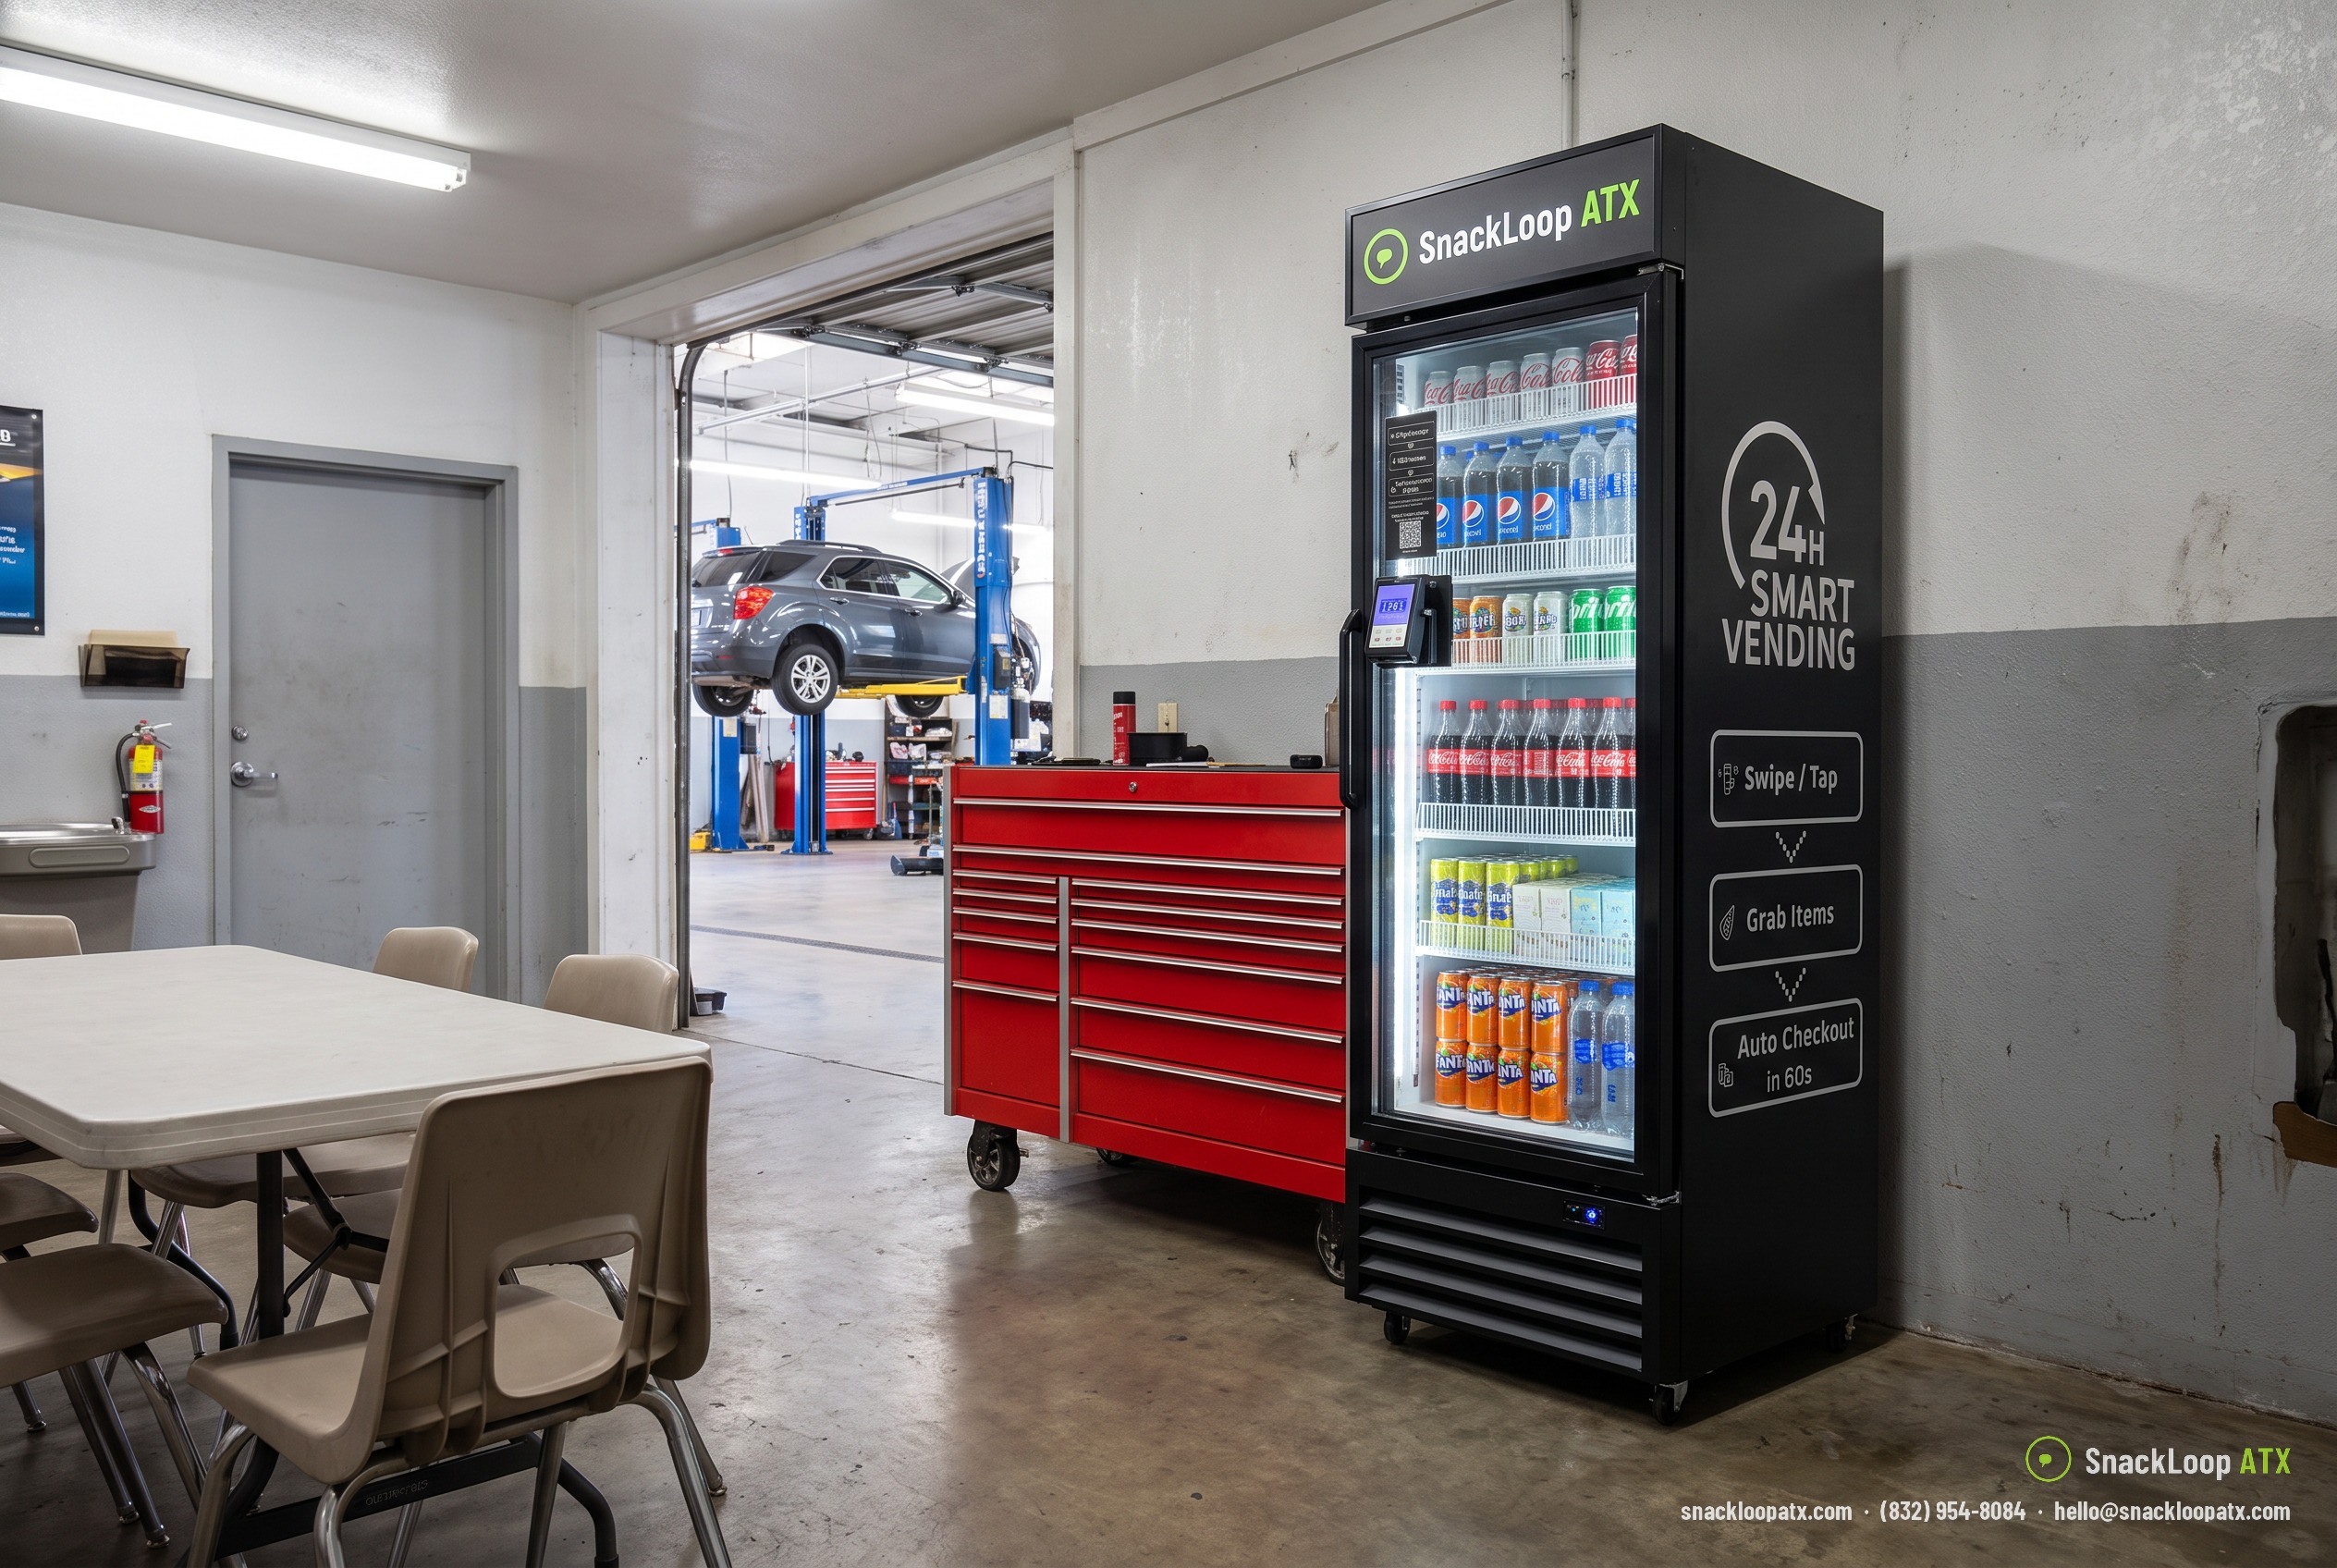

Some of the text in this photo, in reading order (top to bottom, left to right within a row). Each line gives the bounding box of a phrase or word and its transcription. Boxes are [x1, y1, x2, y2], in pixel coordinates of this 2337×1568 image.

[1418, 179, 1640, 264] SnackLoop ATX
[1750, 480, 1824, 566] 24H
[1751, 570, 1854, 622] SMART
[1722, 619, 1854, 670] VENDING
[1745, 764, 1838, 795] Swipe / Tap
[1747, 904, 1834, 932] Grab Items
[1738, 1017, 1854, 1059] Auto Checkout
[1767, 1065, 1812, 1092] in 60s
